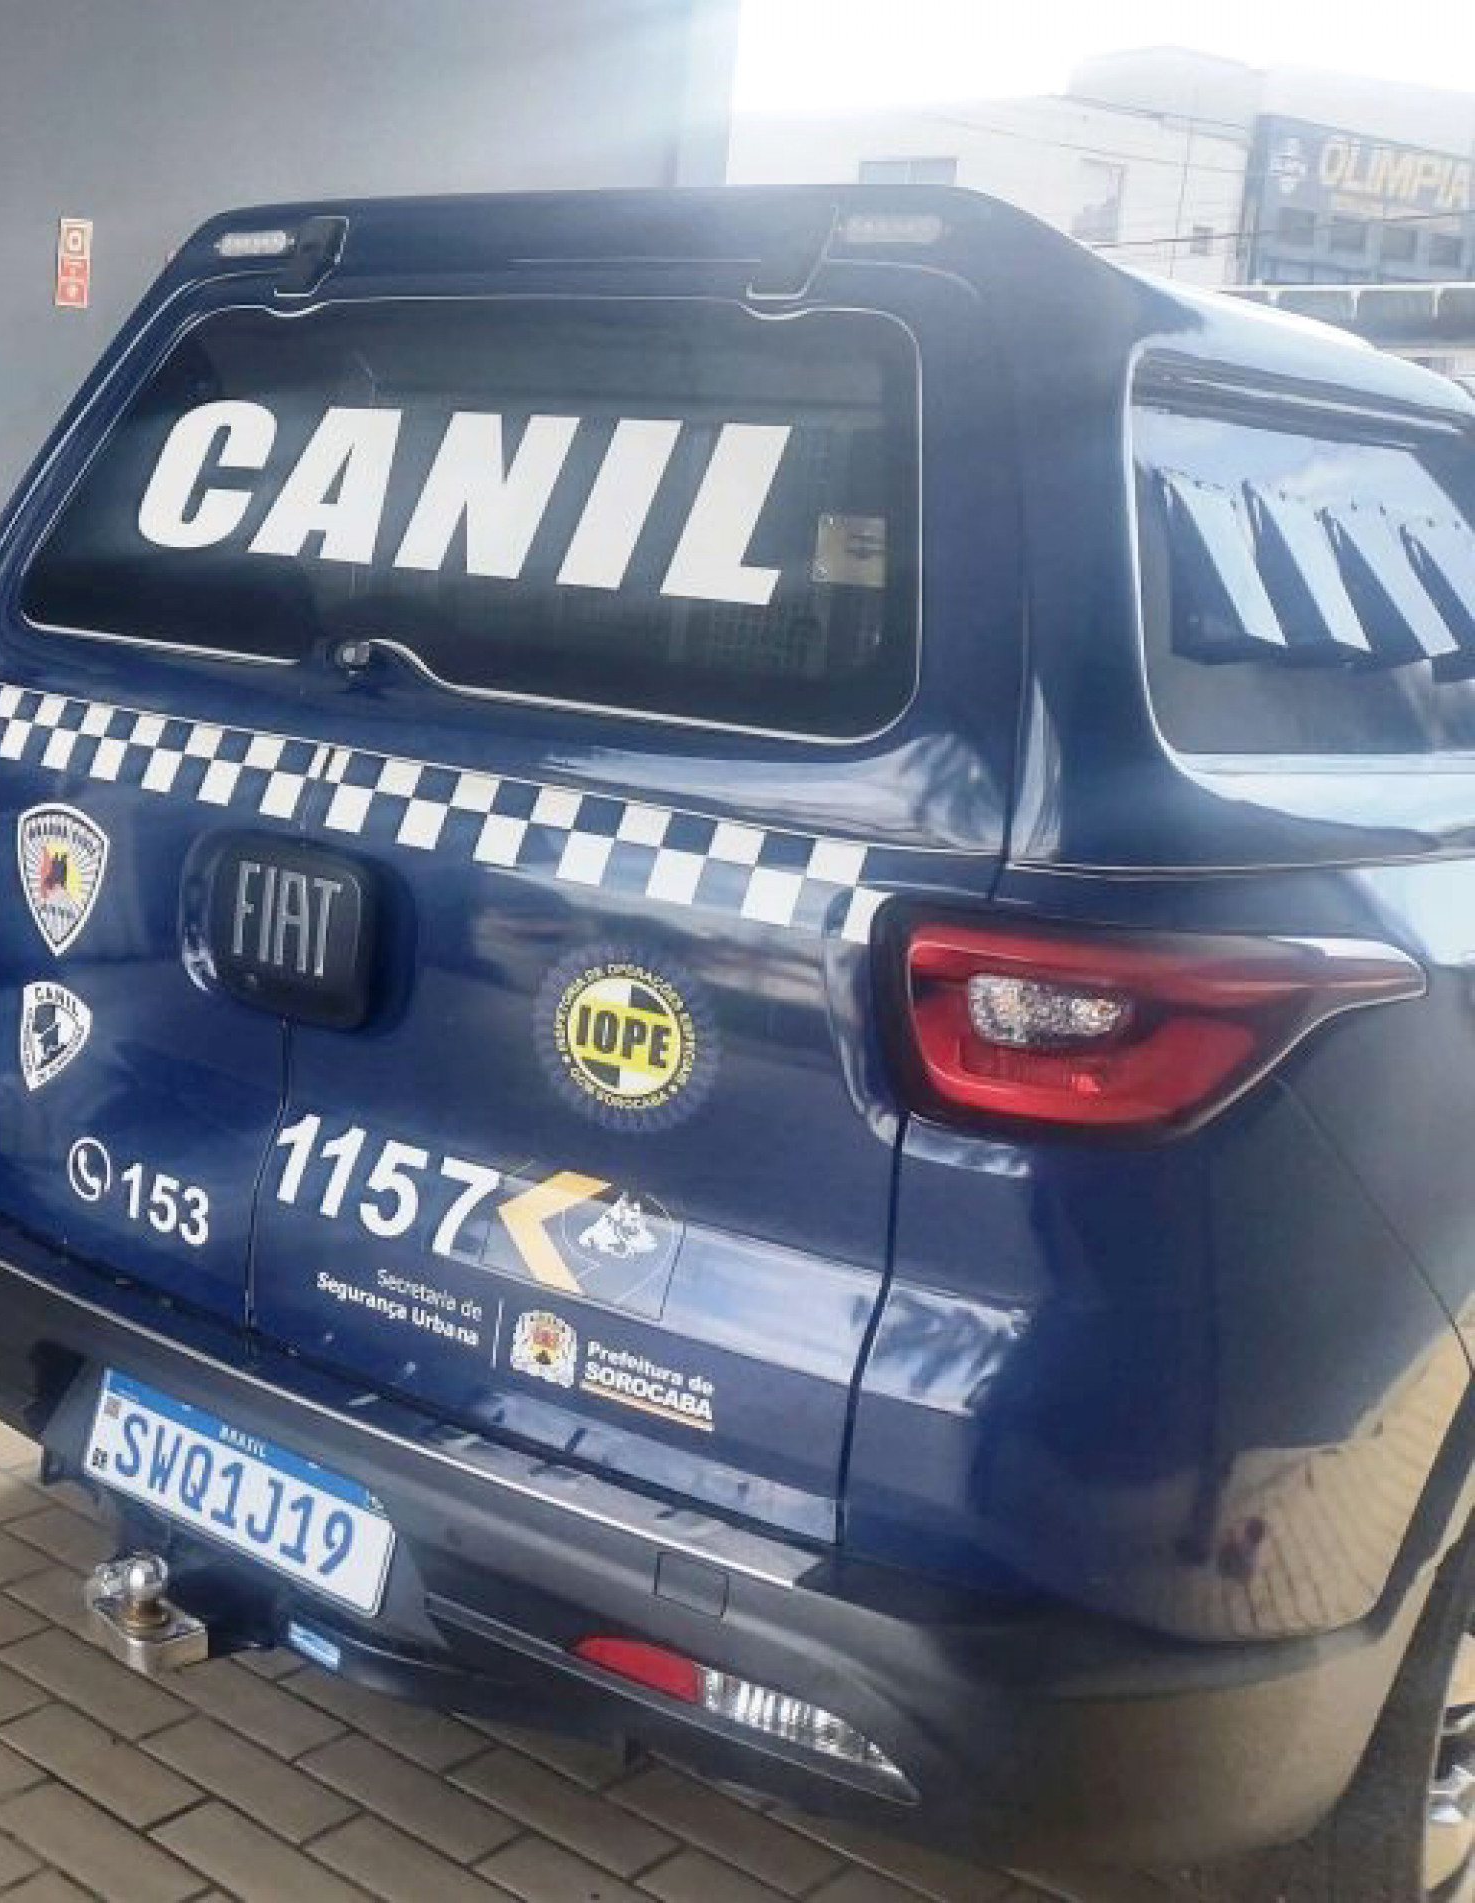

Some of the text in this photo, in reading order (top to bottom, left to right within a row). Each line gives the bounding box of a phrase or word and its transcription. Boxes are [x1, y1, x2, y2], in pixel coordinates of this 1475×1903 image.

[137, 400, 792, 605] CANIL
[232, 861, 343, 977] FIAT
[34, 986, 79, 1017] CANIL
[575, 1003, 673, 1069] IOPE
[121, 1162, 209, 1246] 153
[276, 1114, 501, 1256] 1157
[316, 1271, 480, 1346] Segurança Urbana
[377, 1268, 483, 1322] Secretaria de
[584, 1361, 714, 1421] SOROCABA
[587, 1341, 715, 1397] Prefeitura de
[114, 1412, 356, 1575] SWQ1J19
